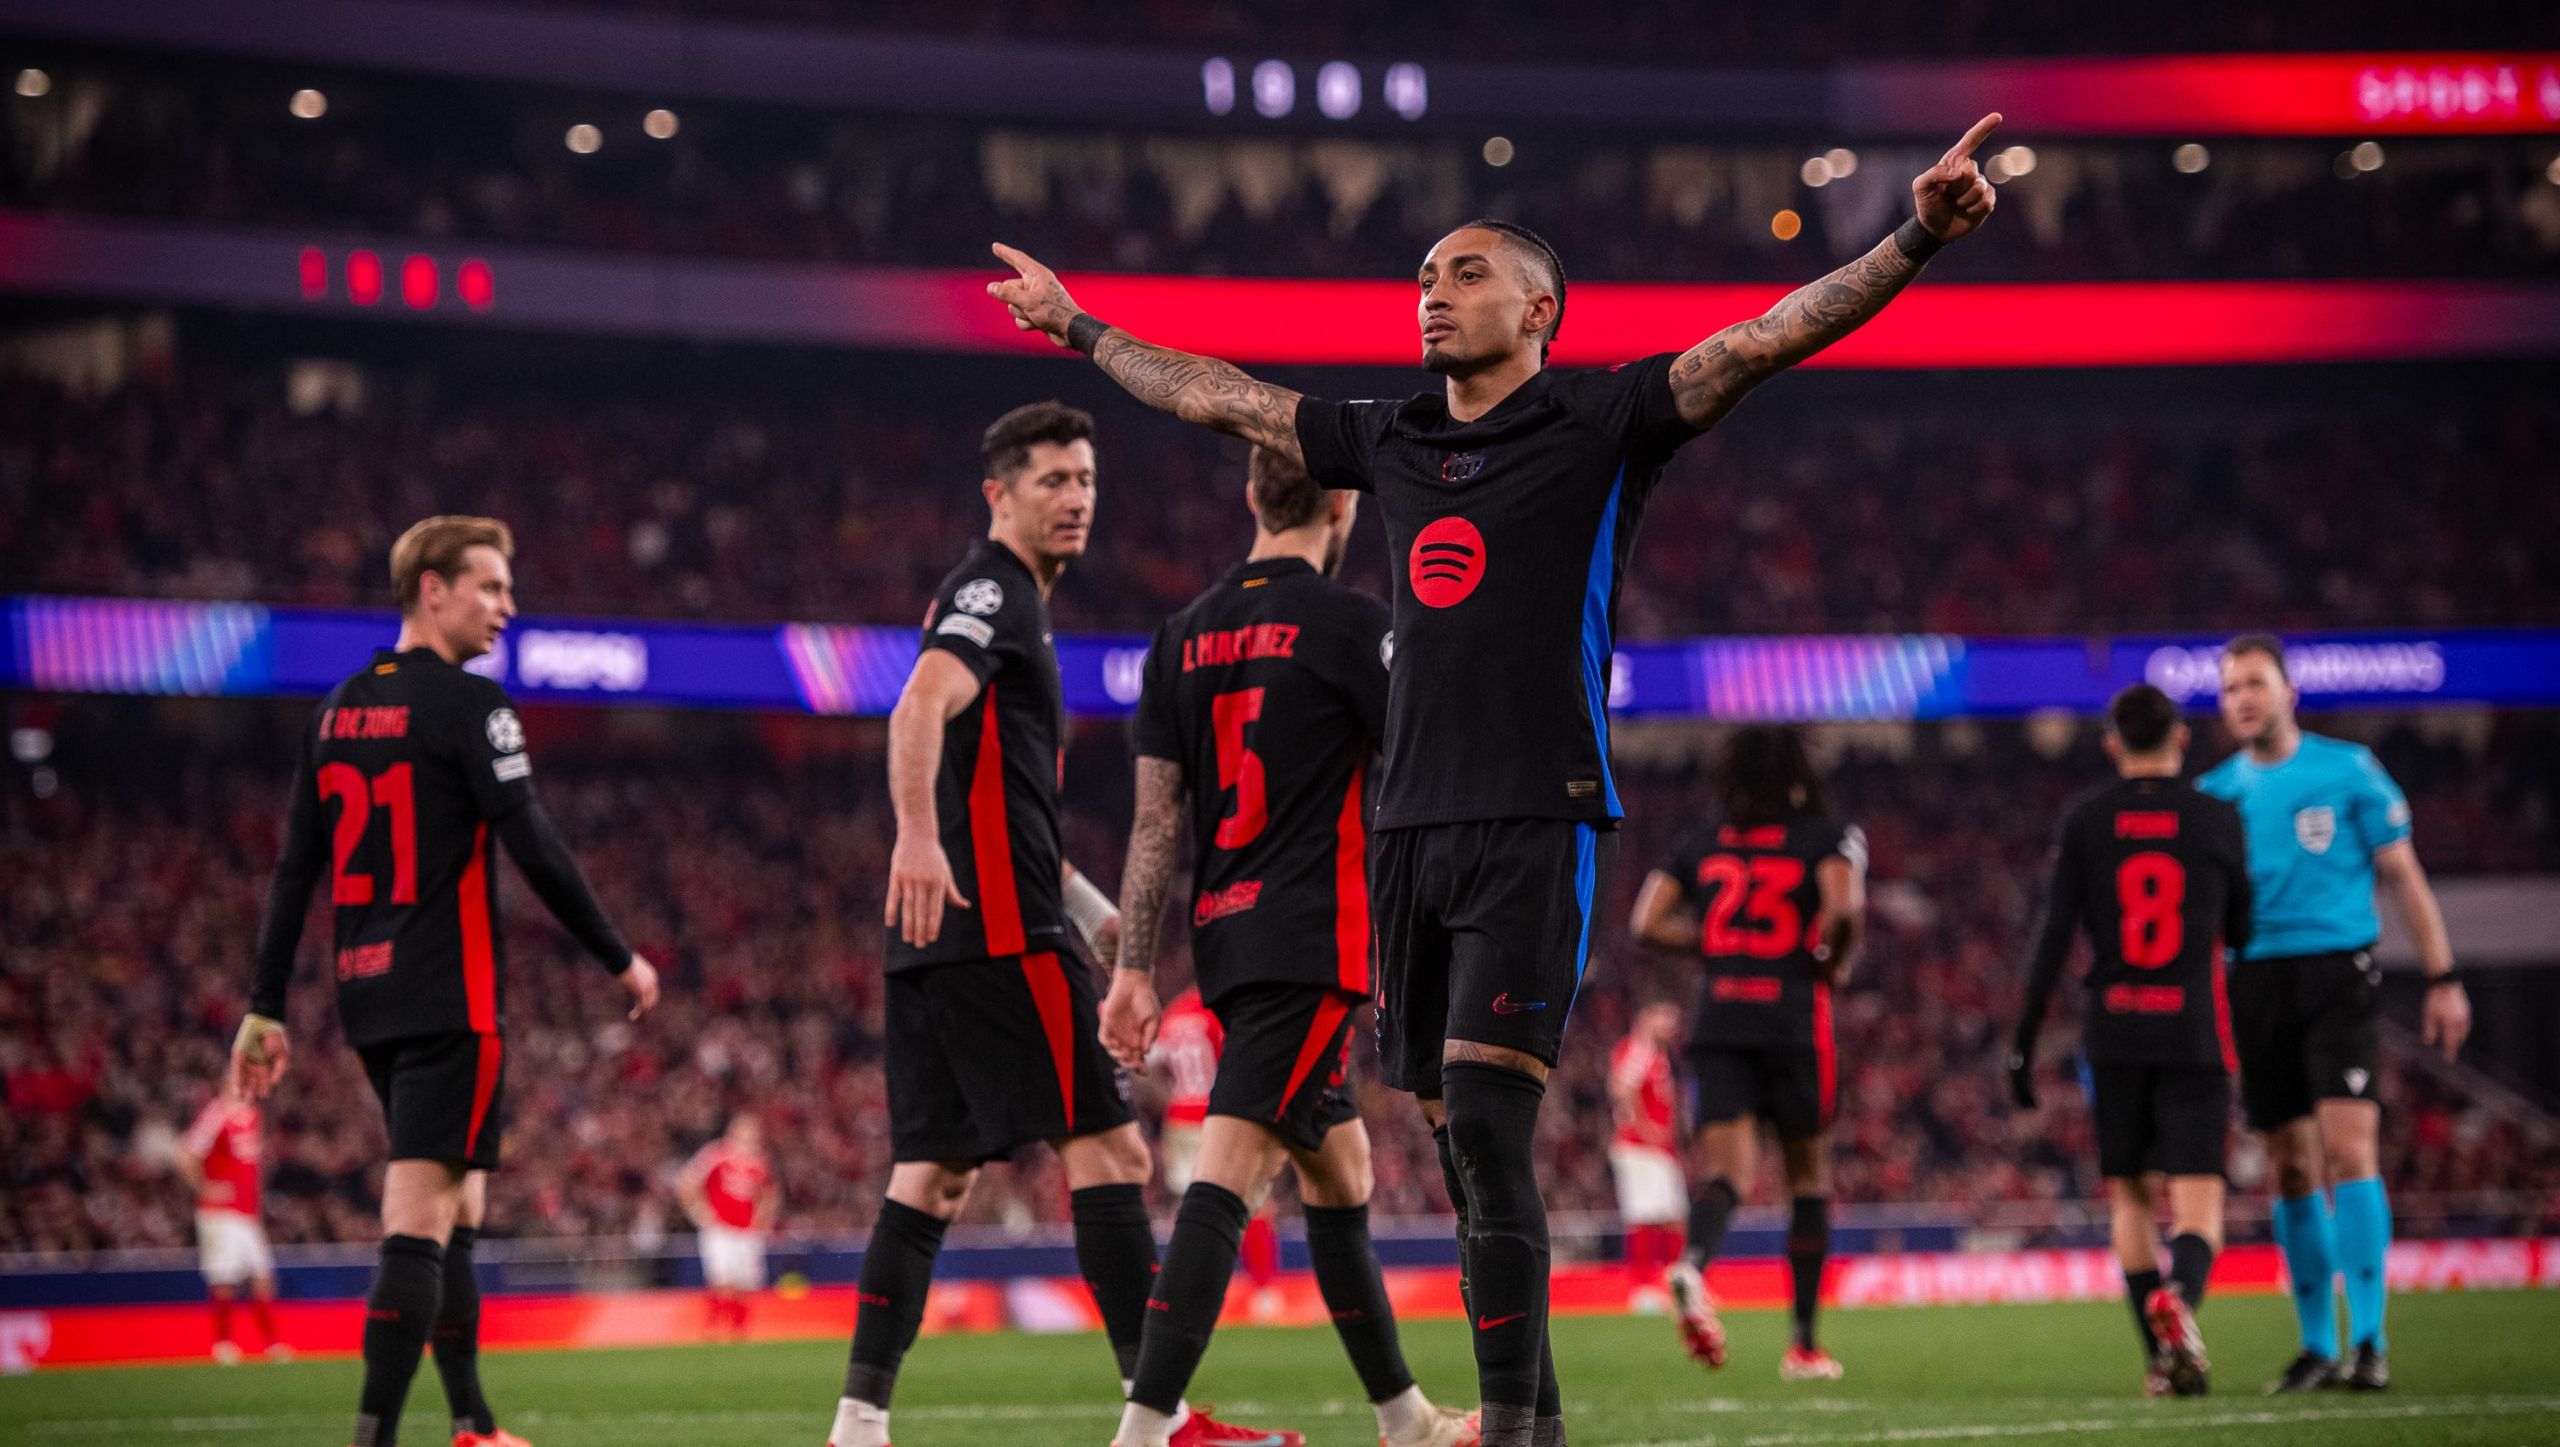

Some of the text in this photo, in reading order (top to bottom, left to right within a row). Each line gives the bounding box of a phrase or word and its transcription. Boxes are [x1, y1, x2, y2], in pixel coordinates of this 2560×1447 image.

[317, 761, 418, 906] 21
[1212, 687, 1268, 850] 5
[1698, 854, 1805, 960] 23
[2115, 850, 2187, 970] 8
